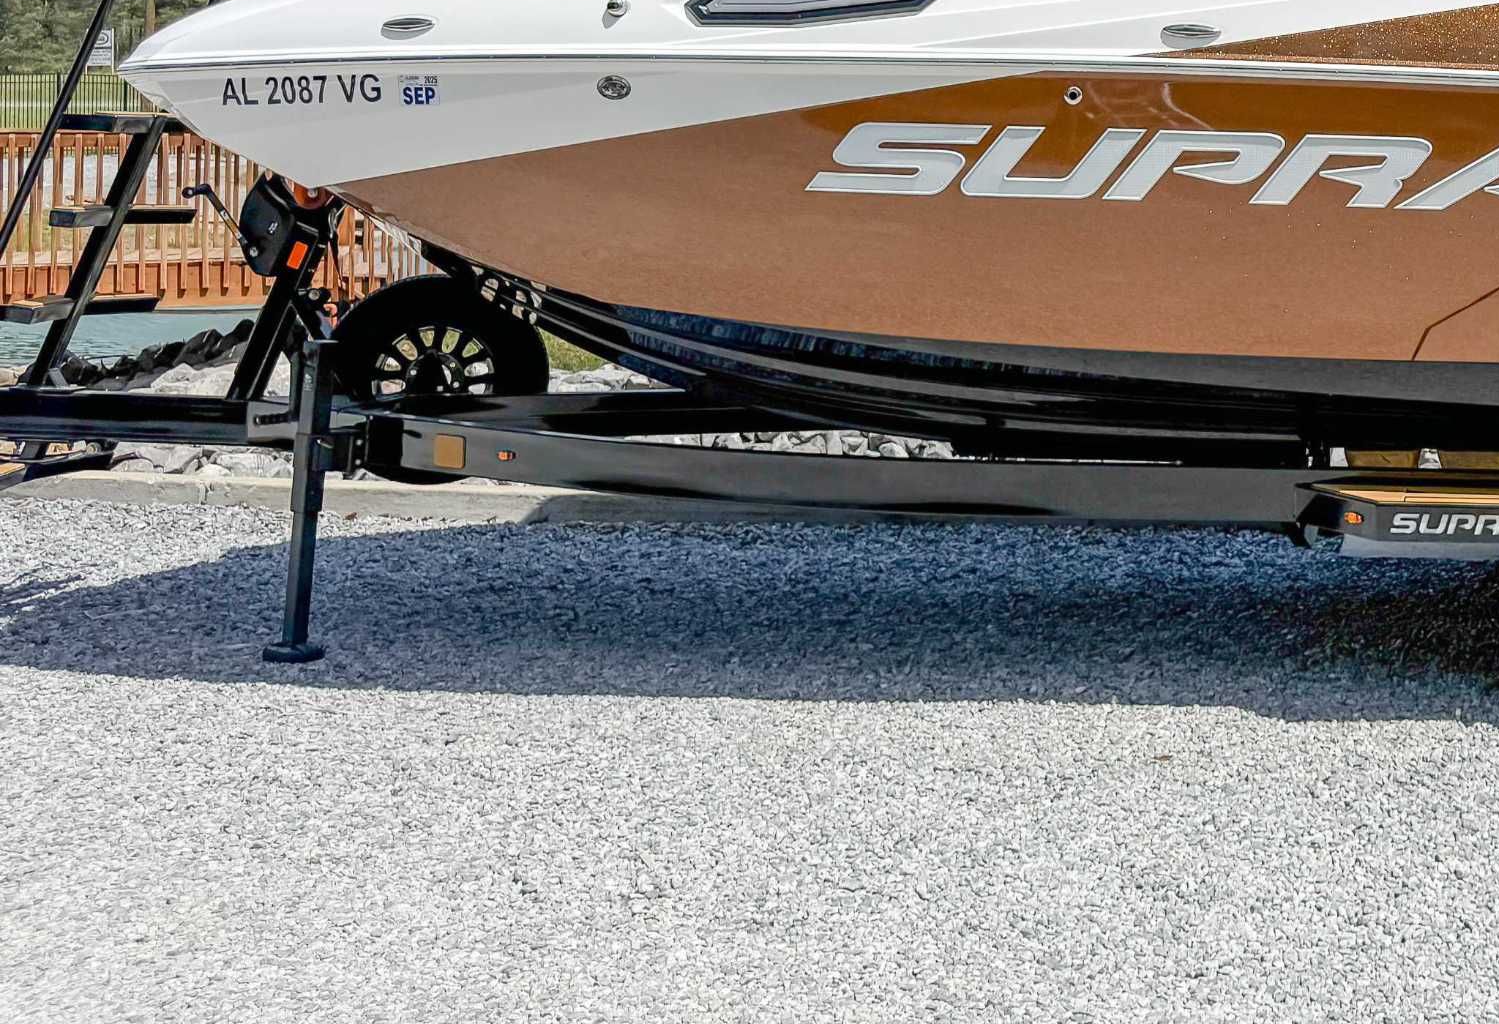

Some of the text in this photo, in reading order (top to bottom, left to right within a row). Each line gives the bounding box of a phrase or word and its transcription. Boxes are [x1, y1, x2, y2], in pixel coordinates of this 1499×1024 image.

[222, 73, 382, 106] AL 2087 VG
[403, 86, 436, 105] SEP
